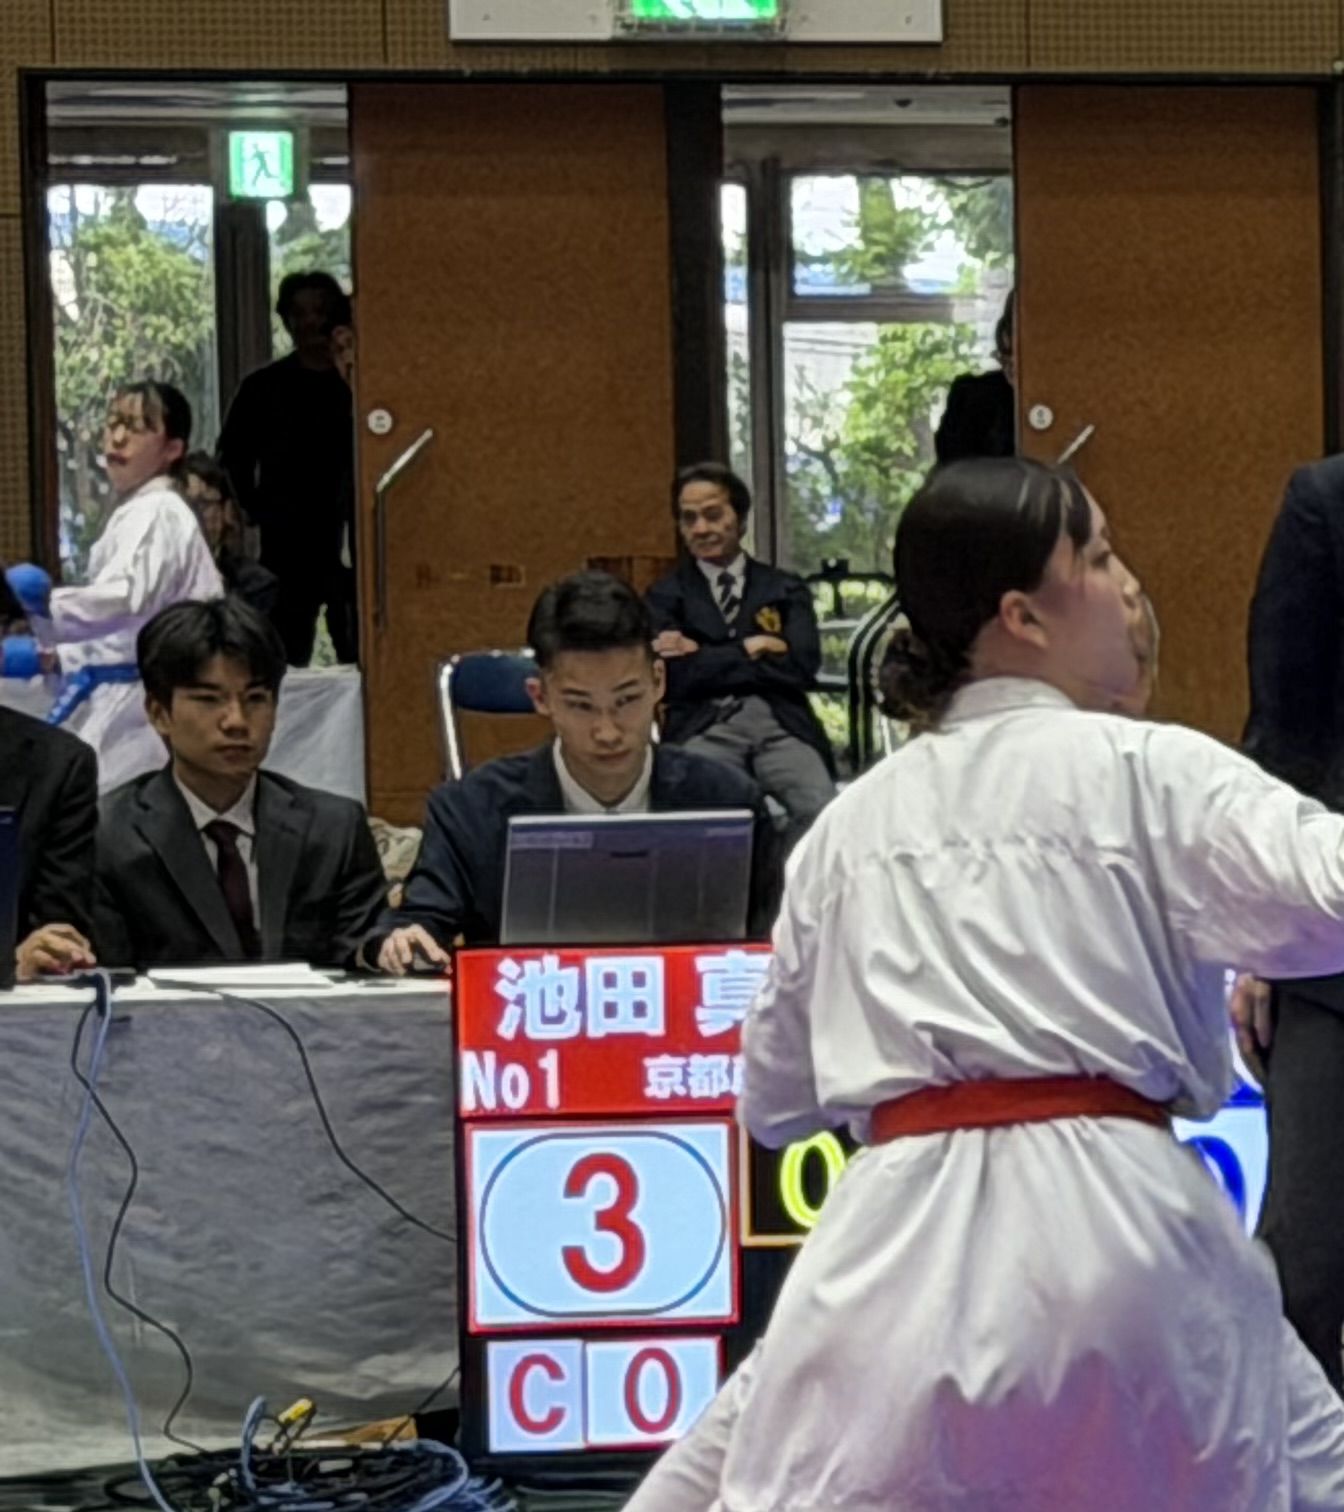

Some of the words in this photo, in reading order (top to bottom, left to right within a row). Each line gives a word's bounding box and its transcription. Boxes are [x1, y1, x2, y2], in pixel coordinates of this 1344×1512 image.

[494, 952, 666, 1041] 池田
[460, 1048, 560, 1112] No1
[561, 1151, 646, 1294] 3
[508, 1352, 567, 1435] C
[623, 1346, 684, 1435] 0
